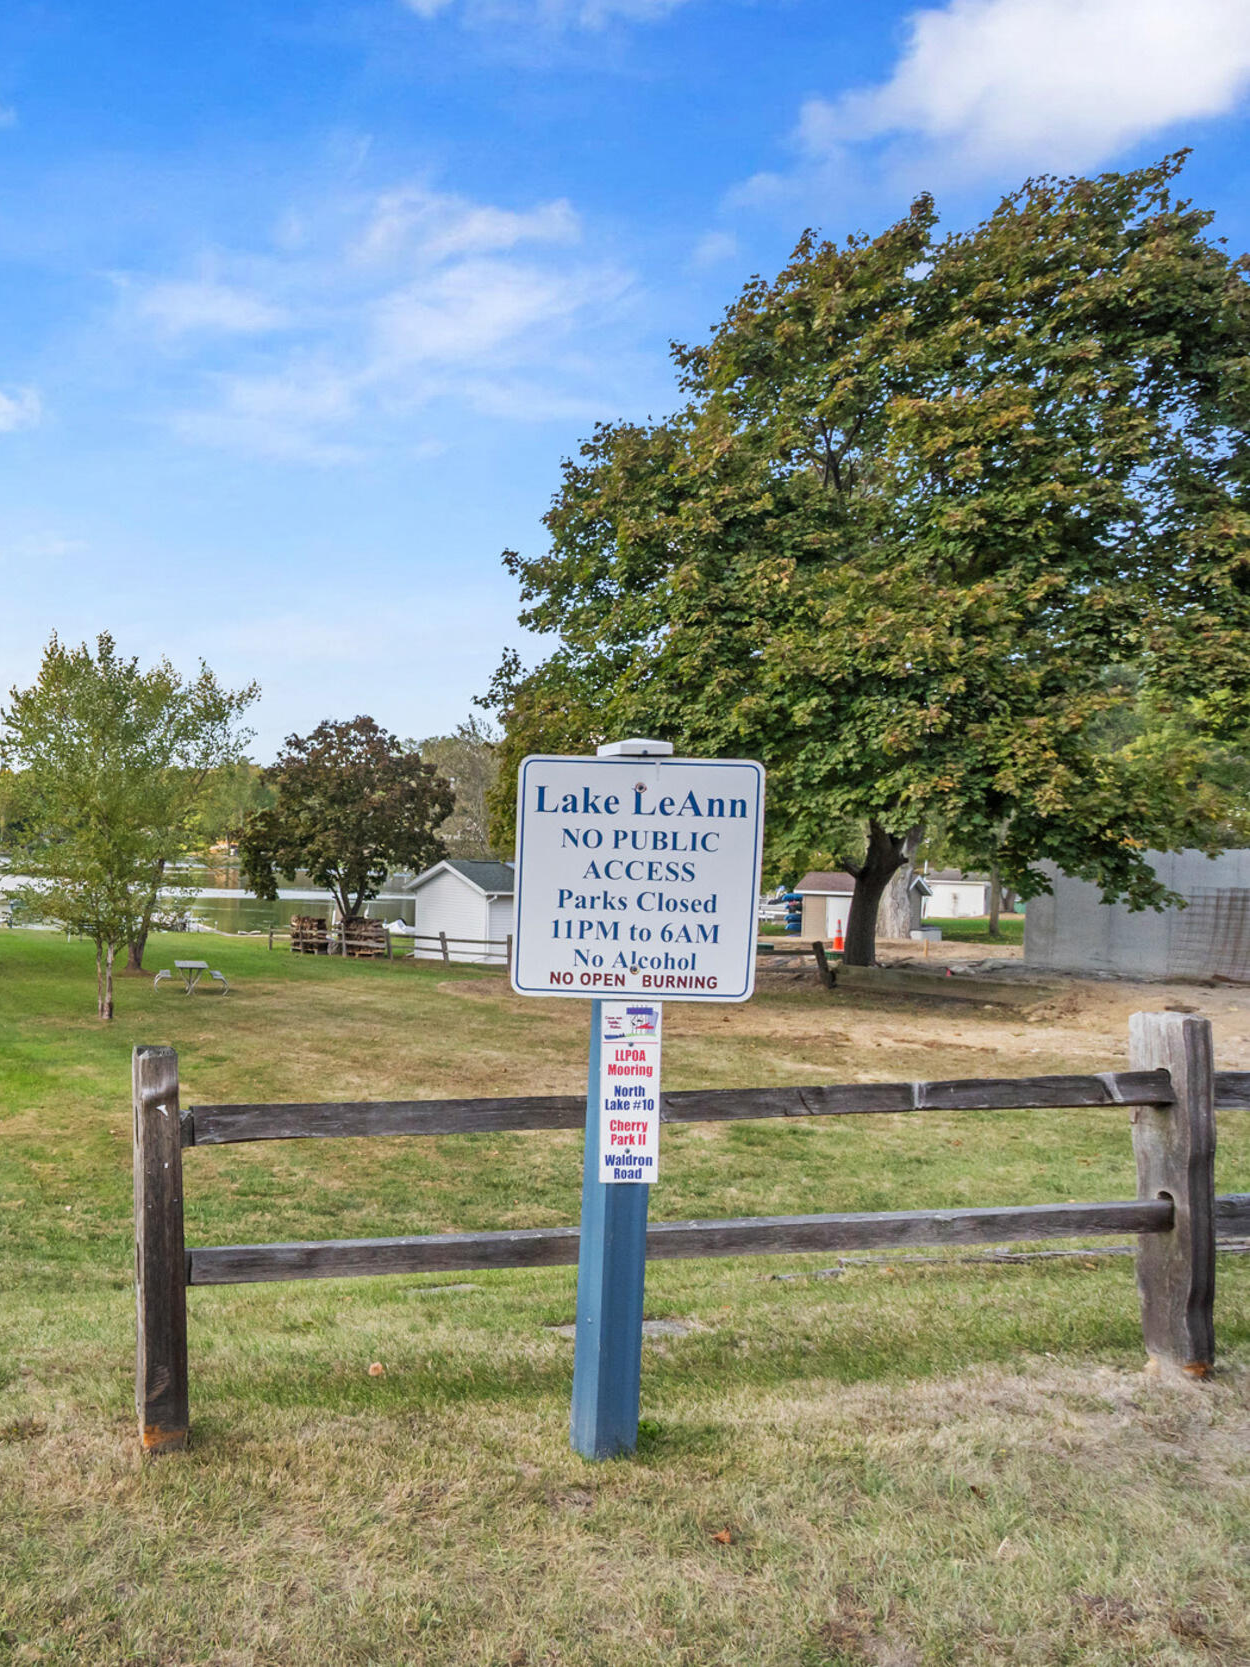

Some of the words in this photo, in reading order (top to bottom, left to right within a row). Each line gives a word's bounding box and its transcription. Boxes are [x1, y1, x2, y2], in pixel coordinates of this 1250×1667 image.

[534, 785, 620, 813] Lake
[631, 786, 748, 819] LeAnn
[561, 828, 603, 849] NO
[613, 830, 720, 852] PUBLIC
[583, 860, 695, 882] ACCESS
[557, 889, 627, 911] Parks
[637, 892, 717, 913] Closed
[550, 919, 619, 940] 11PM
[630, 925, 651, 942] to
[661, 923, 719, 944] 6AM
[574, 949, 603, 968] No
[612, 951, 696, 971] Alcohol
[550, 972, 574, 985] NO
[580, 973, 625, 986] OPEN
[642, 974, 718, 989] BURNING
[615, 1050, 646, 1061] LLPOA
[608, 1064, 653, 1077] Mooring
[614, 1085, 645, 1097] North
[605, 1099, 630, 1111] Lake
[633, 1099, 654, 1111] #10
[610, 1119, 647, 1132] Cherry
[611, 1134, 635, 1145] Park
[605, 1155, 652, 1166] Waldron
[614, 1168, 642, 1179] Road
